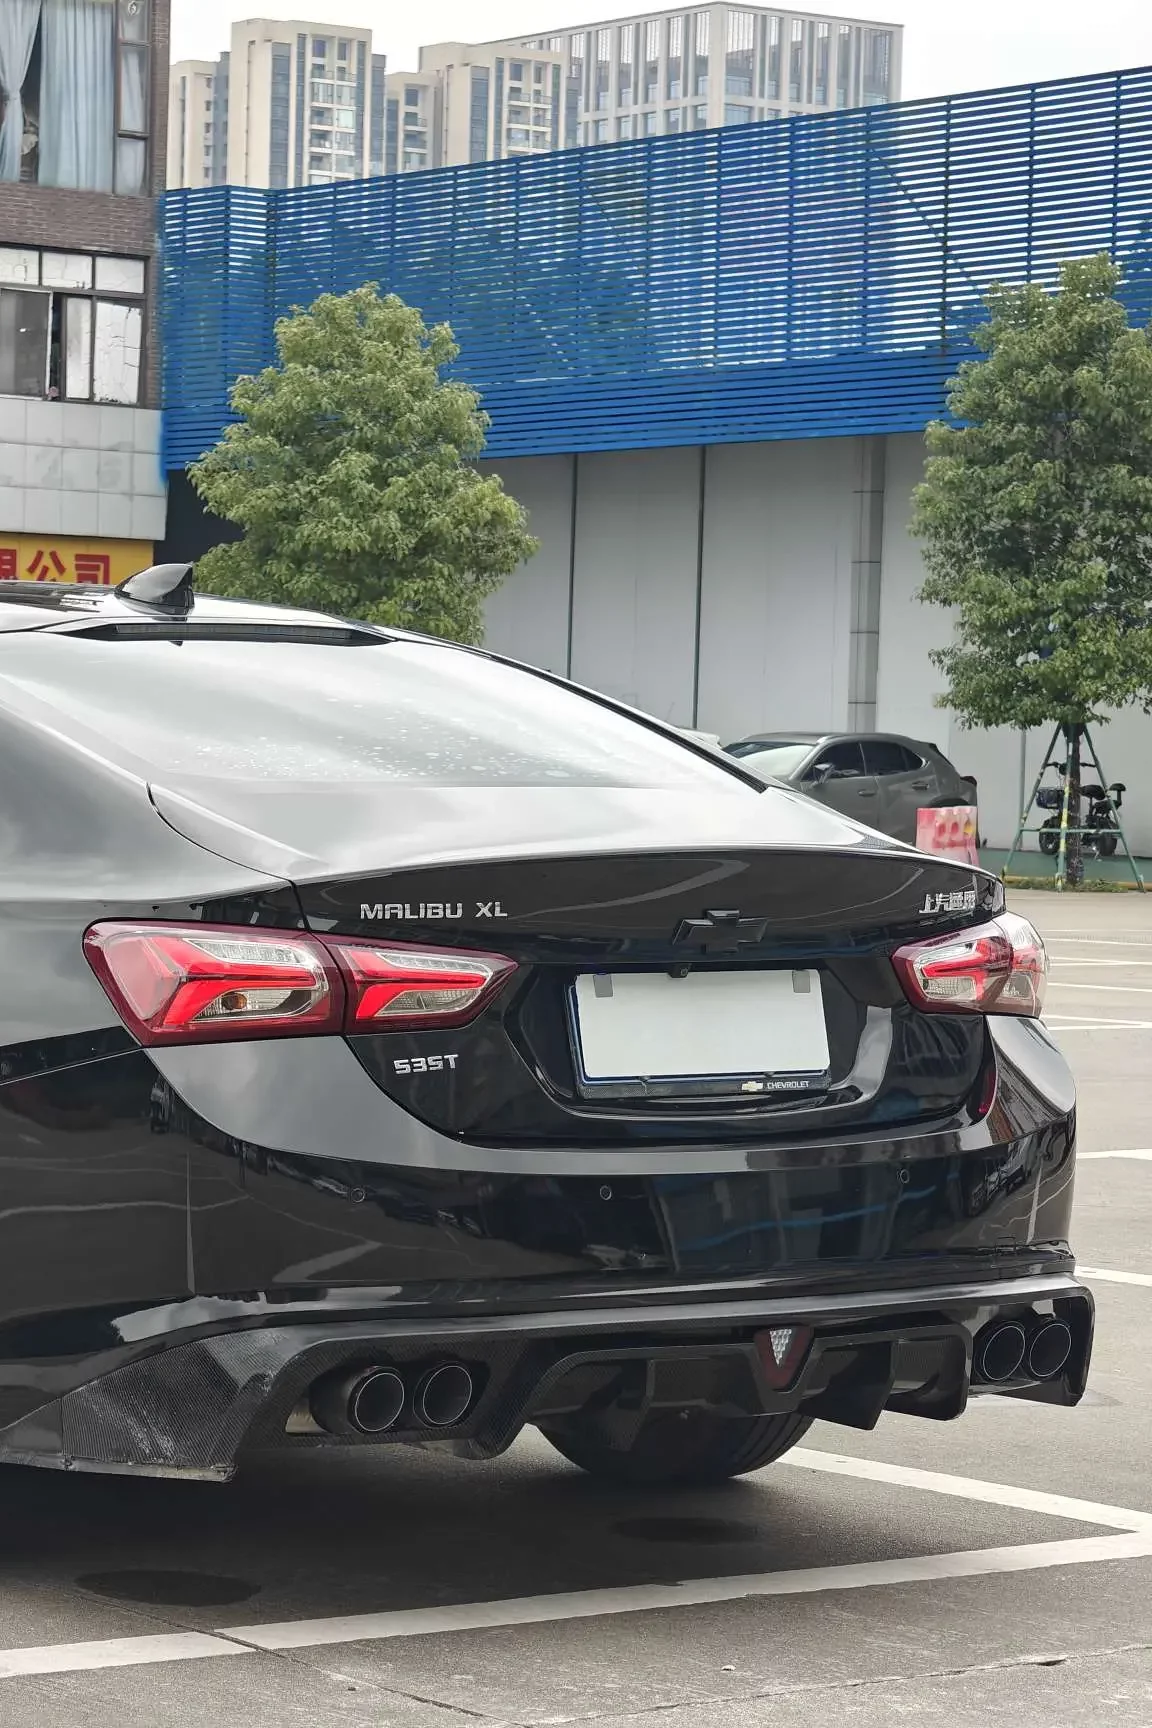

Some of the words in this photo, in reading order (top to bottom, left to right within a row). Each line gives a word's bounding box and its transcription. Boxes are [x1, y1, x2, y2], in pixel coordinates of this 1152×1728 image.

[360, 902, 463, 919] MALIBU
[474, 901, 508, 918] XL
[393, 1054, 459, 1075] 535T
[767, 1080, 810, 1090] CHEVROLET
